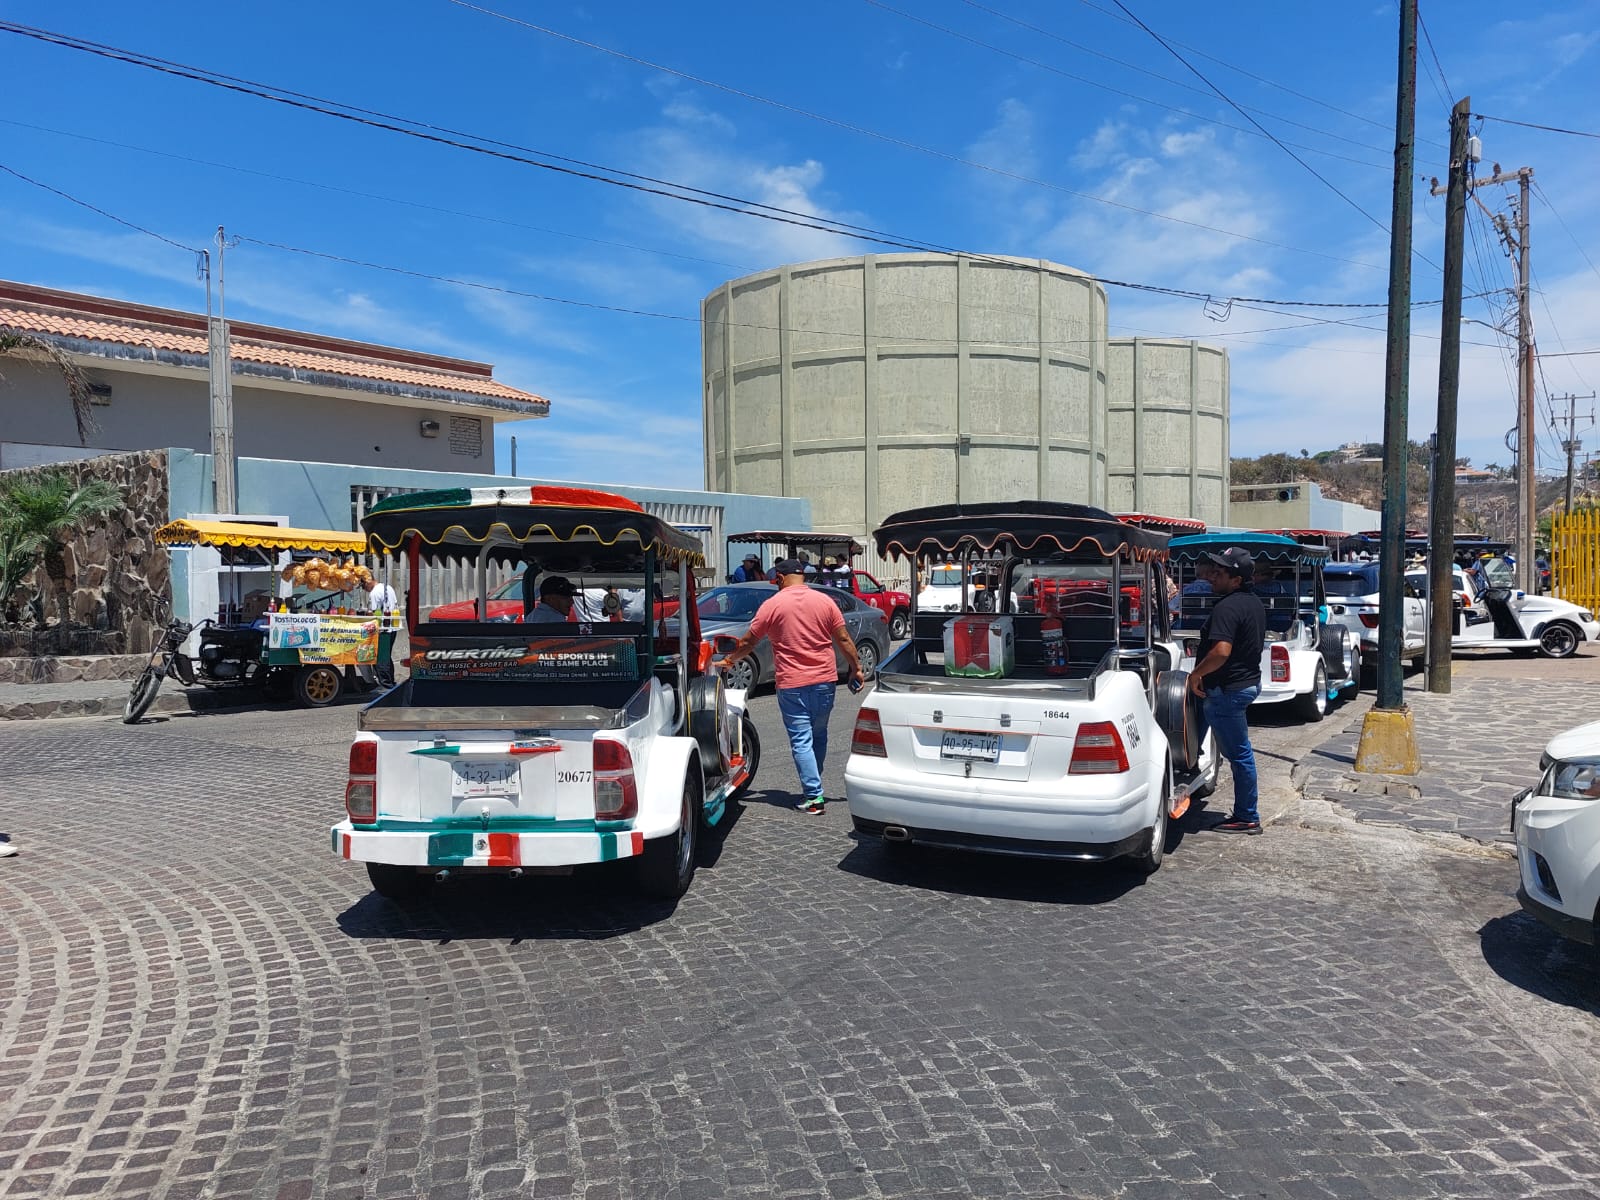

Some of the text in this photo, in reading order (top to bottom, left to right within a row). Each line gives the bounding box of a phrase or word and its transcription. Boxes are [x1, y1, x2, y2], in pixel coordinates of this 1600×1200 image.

[426, 645, 528, 659] OVERTIME
[1043, 710, 1070, 720] 18644
[557, 771, 592, 783] 20677
